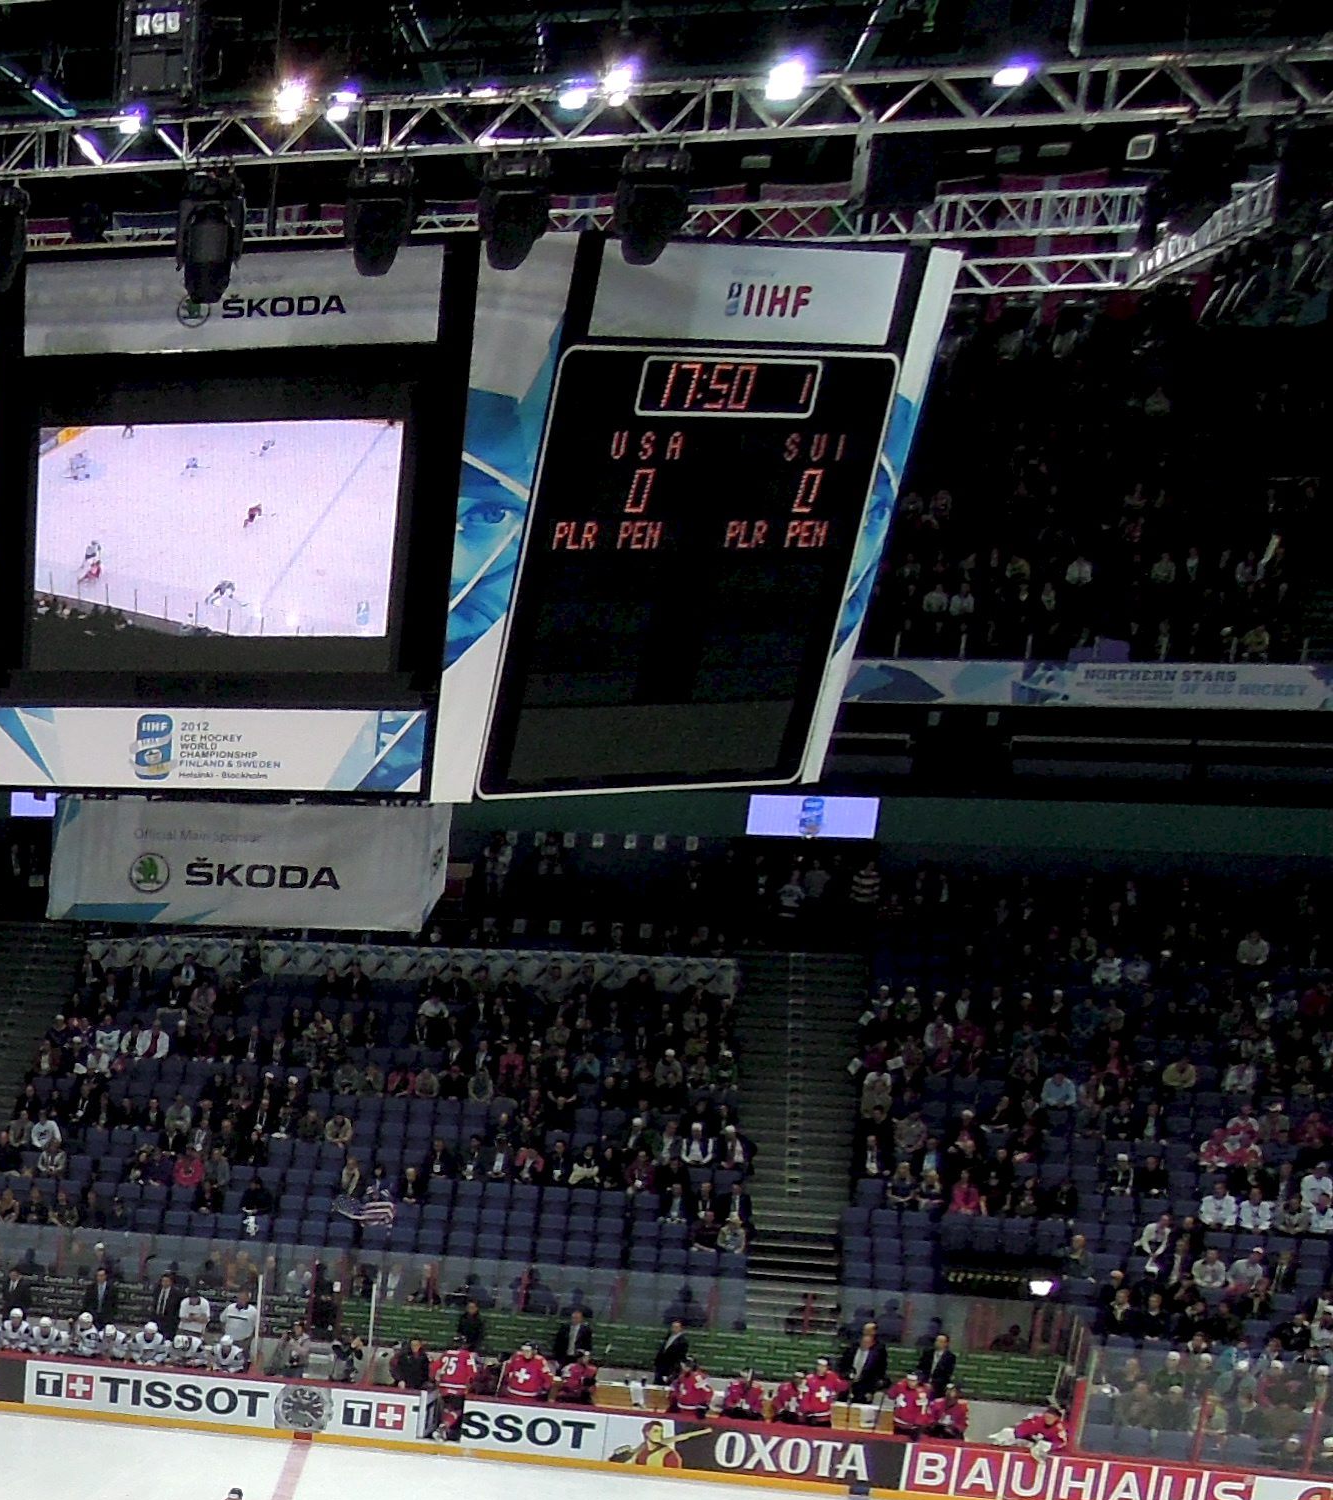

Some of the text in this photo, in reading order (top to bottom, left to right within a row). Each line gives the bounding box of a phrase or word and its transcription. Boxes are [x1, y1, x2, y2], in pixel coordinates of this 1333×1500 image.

[222, 294, 346, 319] ŠKODA
[743, 283, 813, 318] IIHF
[660, 362, 758, 411] 17:50
[610, 430, 684, 460] USA
[783, 432, 847, 462] SUI
[624, 467, 657, 513] 0
[791, 468, 825, 513] 0
[552, 521, 664, 550] PLR PEN
[724, 520, 829, 548] PLR PEN
[1084, 668, 1237, 683] NORTHERN STARS
[142, 721, 168, 732] IIHF
[180, 722, 209, 731] 2012
[180, 734, 243, 742] ICE HOCKEY
[179, 751, 258, 759] CHAMPIONSHIP
[179, 760, 224, 768] FINLAND
[185, 857, 340, 890] ŠKODA
[99, 1376, 270, 1418] TISSOT
[714, 1431, 869, 1482] ОХОТА
